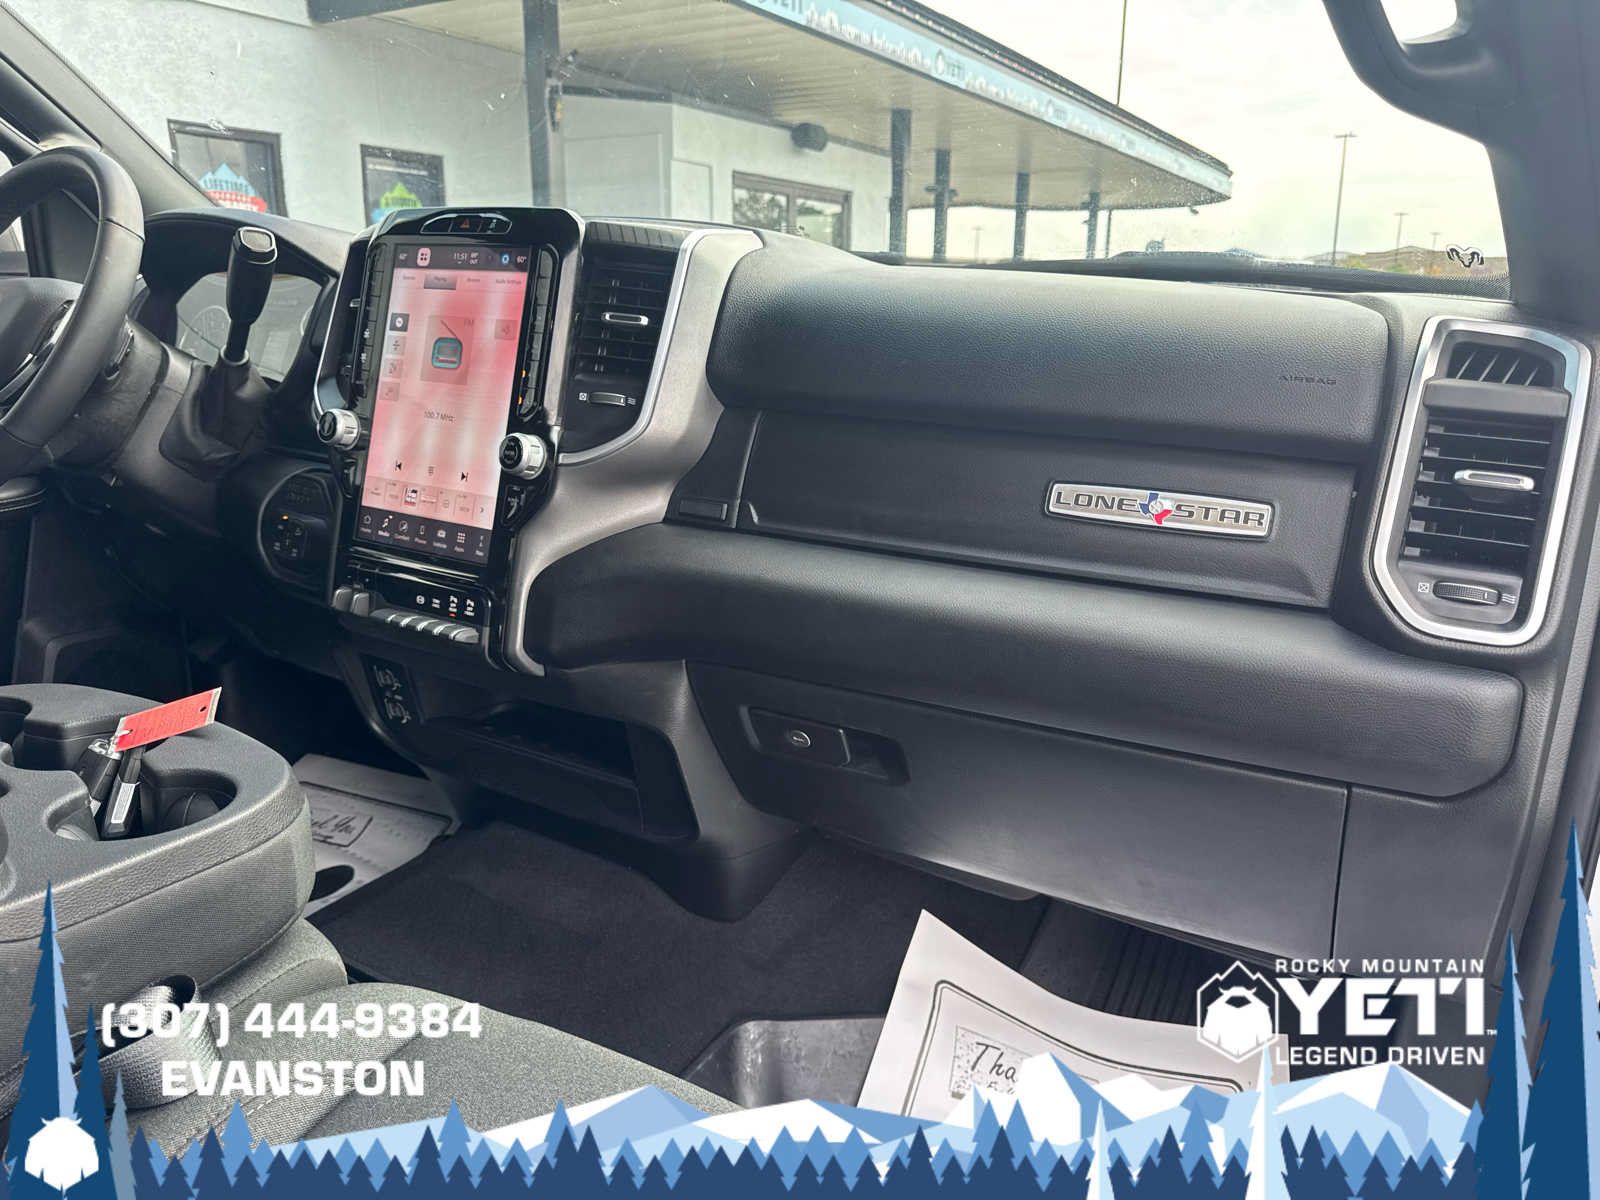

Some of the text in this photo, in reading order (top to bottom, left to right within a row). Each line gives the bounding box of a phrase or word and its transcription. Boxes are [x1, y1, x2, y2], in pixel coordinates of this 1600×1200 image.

[1280, 375, 1337, 386] AIRBAG
[1055, 491, 1266, 527] LONE STAR
[970, 1041, 1018, 1084] Tha
